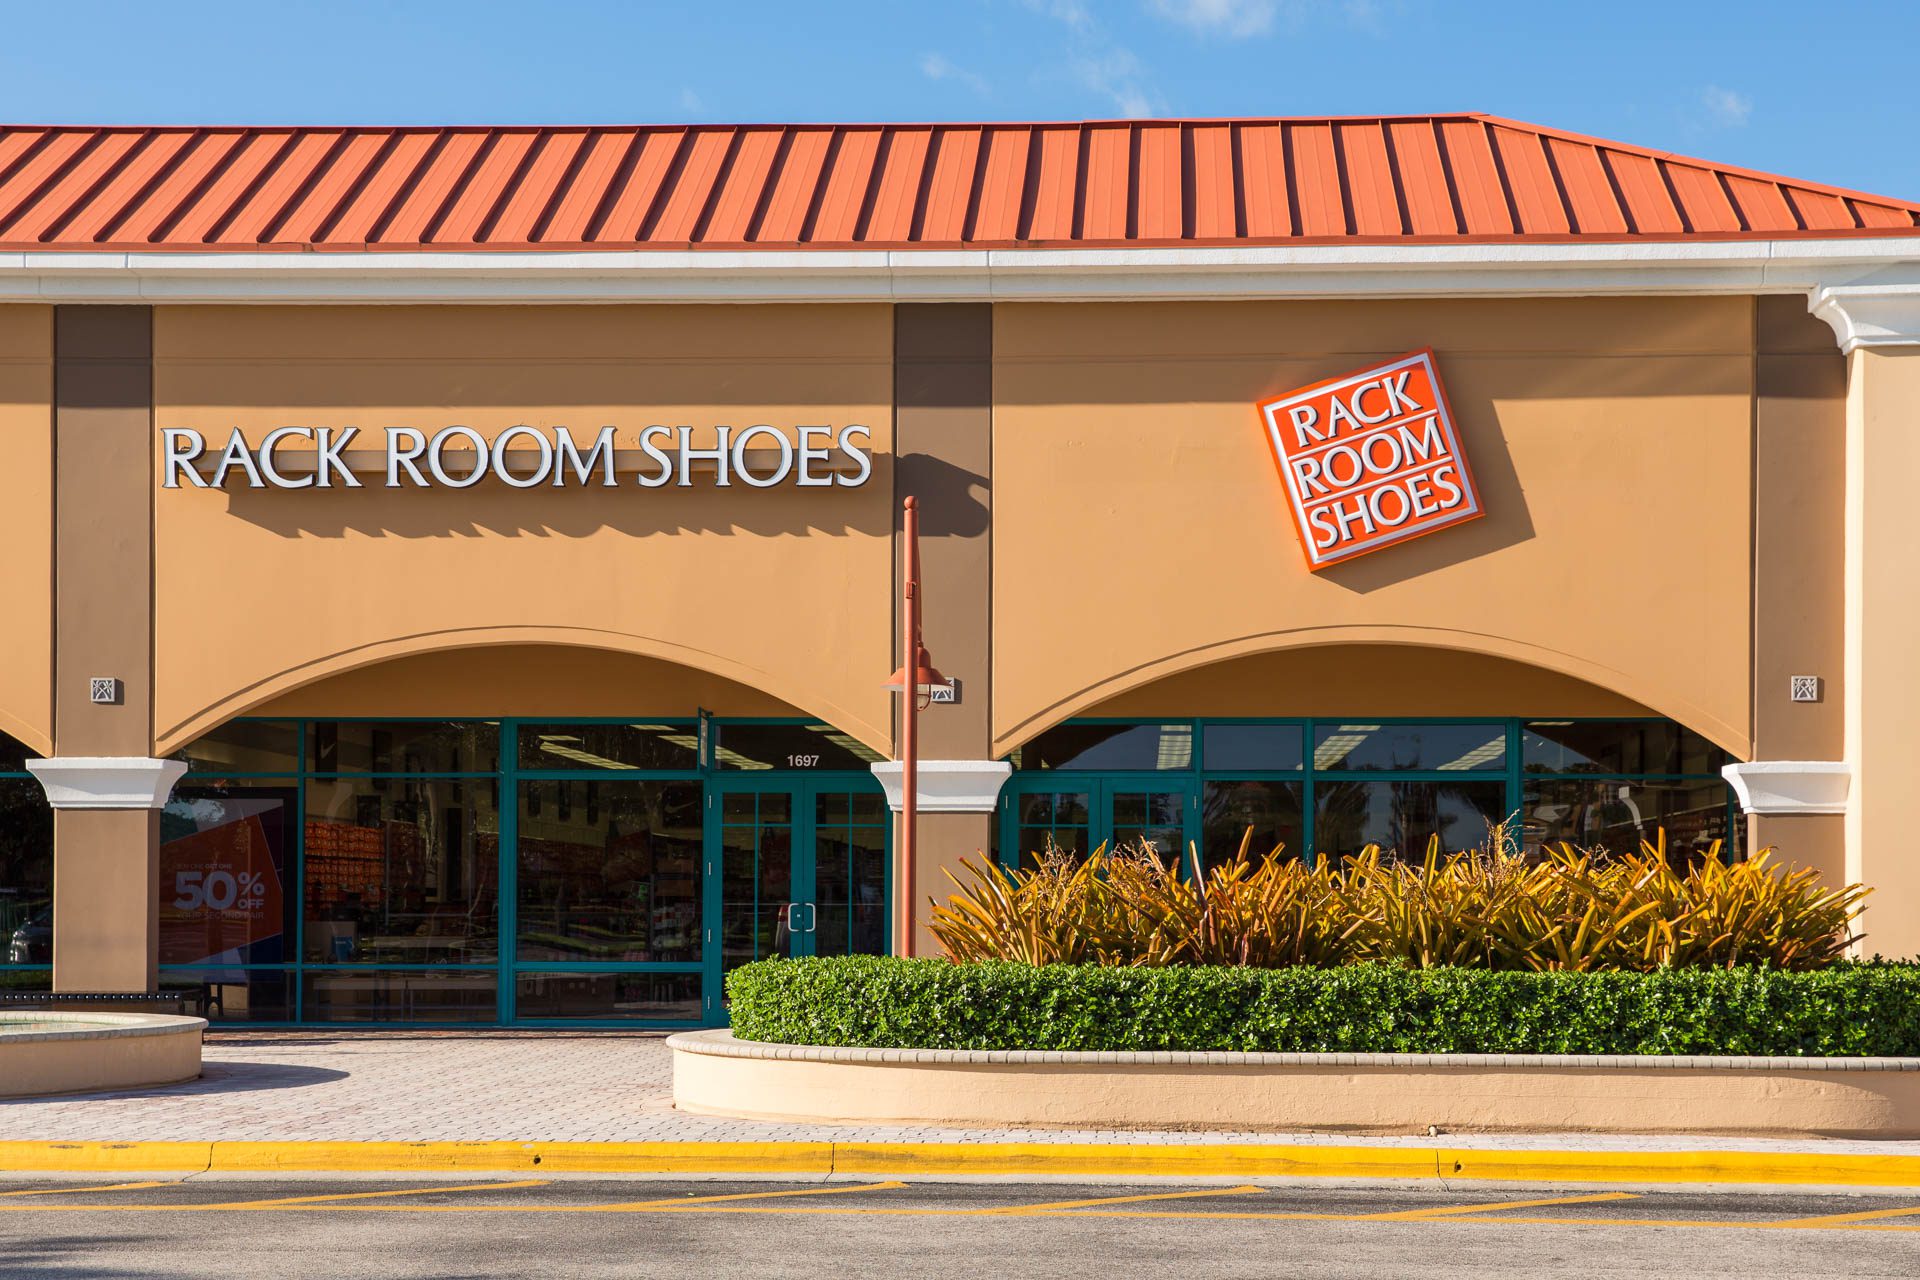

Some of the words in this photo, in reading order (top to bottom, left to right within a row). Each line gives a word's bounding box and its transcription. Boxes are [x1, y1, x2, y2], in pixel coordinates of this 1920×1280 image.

[1288, 371, 1422, 448] RACK
[160, 426, 363, 488] RACK
[384, 425, 618, 488] ROOM
[637, 424, 873, 487] SHOES
[1292, 416, 1448, 500] ROOM
[1310, 465, 1464, 549] SHOES
[787, 754, 820, 767] 1697
[175, 871, 265, 910] 50%
[204, 911, 242, 920] SECOND
[243, 911, 265, 920] PAIR
[237, 898, 265, 910] OFF
